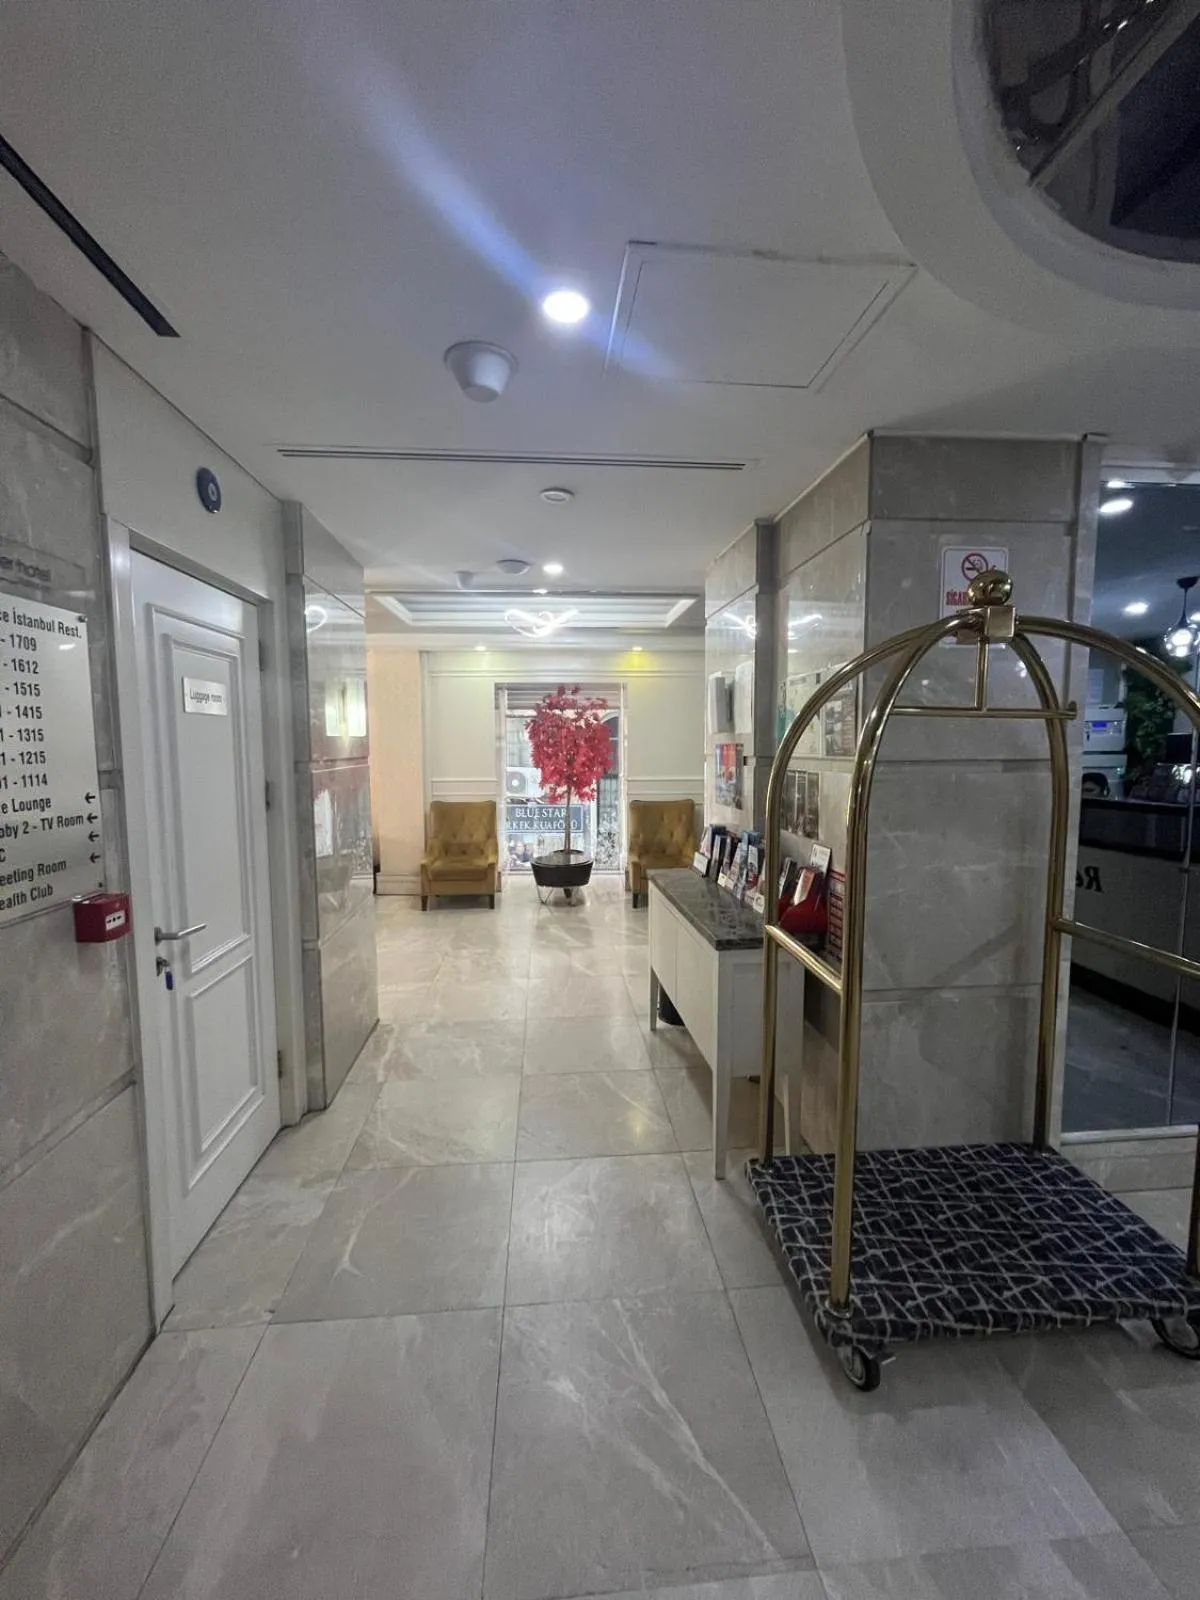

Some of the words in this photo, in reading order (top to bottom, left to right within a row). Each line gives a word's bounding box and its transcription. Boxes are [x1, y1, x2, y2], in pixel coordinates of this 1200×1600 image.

[0, 611, 9, 623] e
[12, 606, 55, 633] İstanbul
[58, 620, 82, 639] Rest.
[9, 632, 37, 652] 1709
[11, 658, 39, 675] 1612
[13, 681, 41, 697] 1515
[15, 704, 43, 720] 1415
[17, 727, 45, 742] 1315
[18, 750, 46, 765] 1215
[0, 774, 8, 790] 1
[20, 773, 48, 788] 1114
[12, 798, 52, 813] Lounge
[515, 807, 540, 818] BLUE
[22, 820, 30, 834] 2
[40, 816, 54, 831] TV
[57, 815, 84, 829] Room
[37, 860, 67, 877] Room
[30, 884, 54, 902] Club
